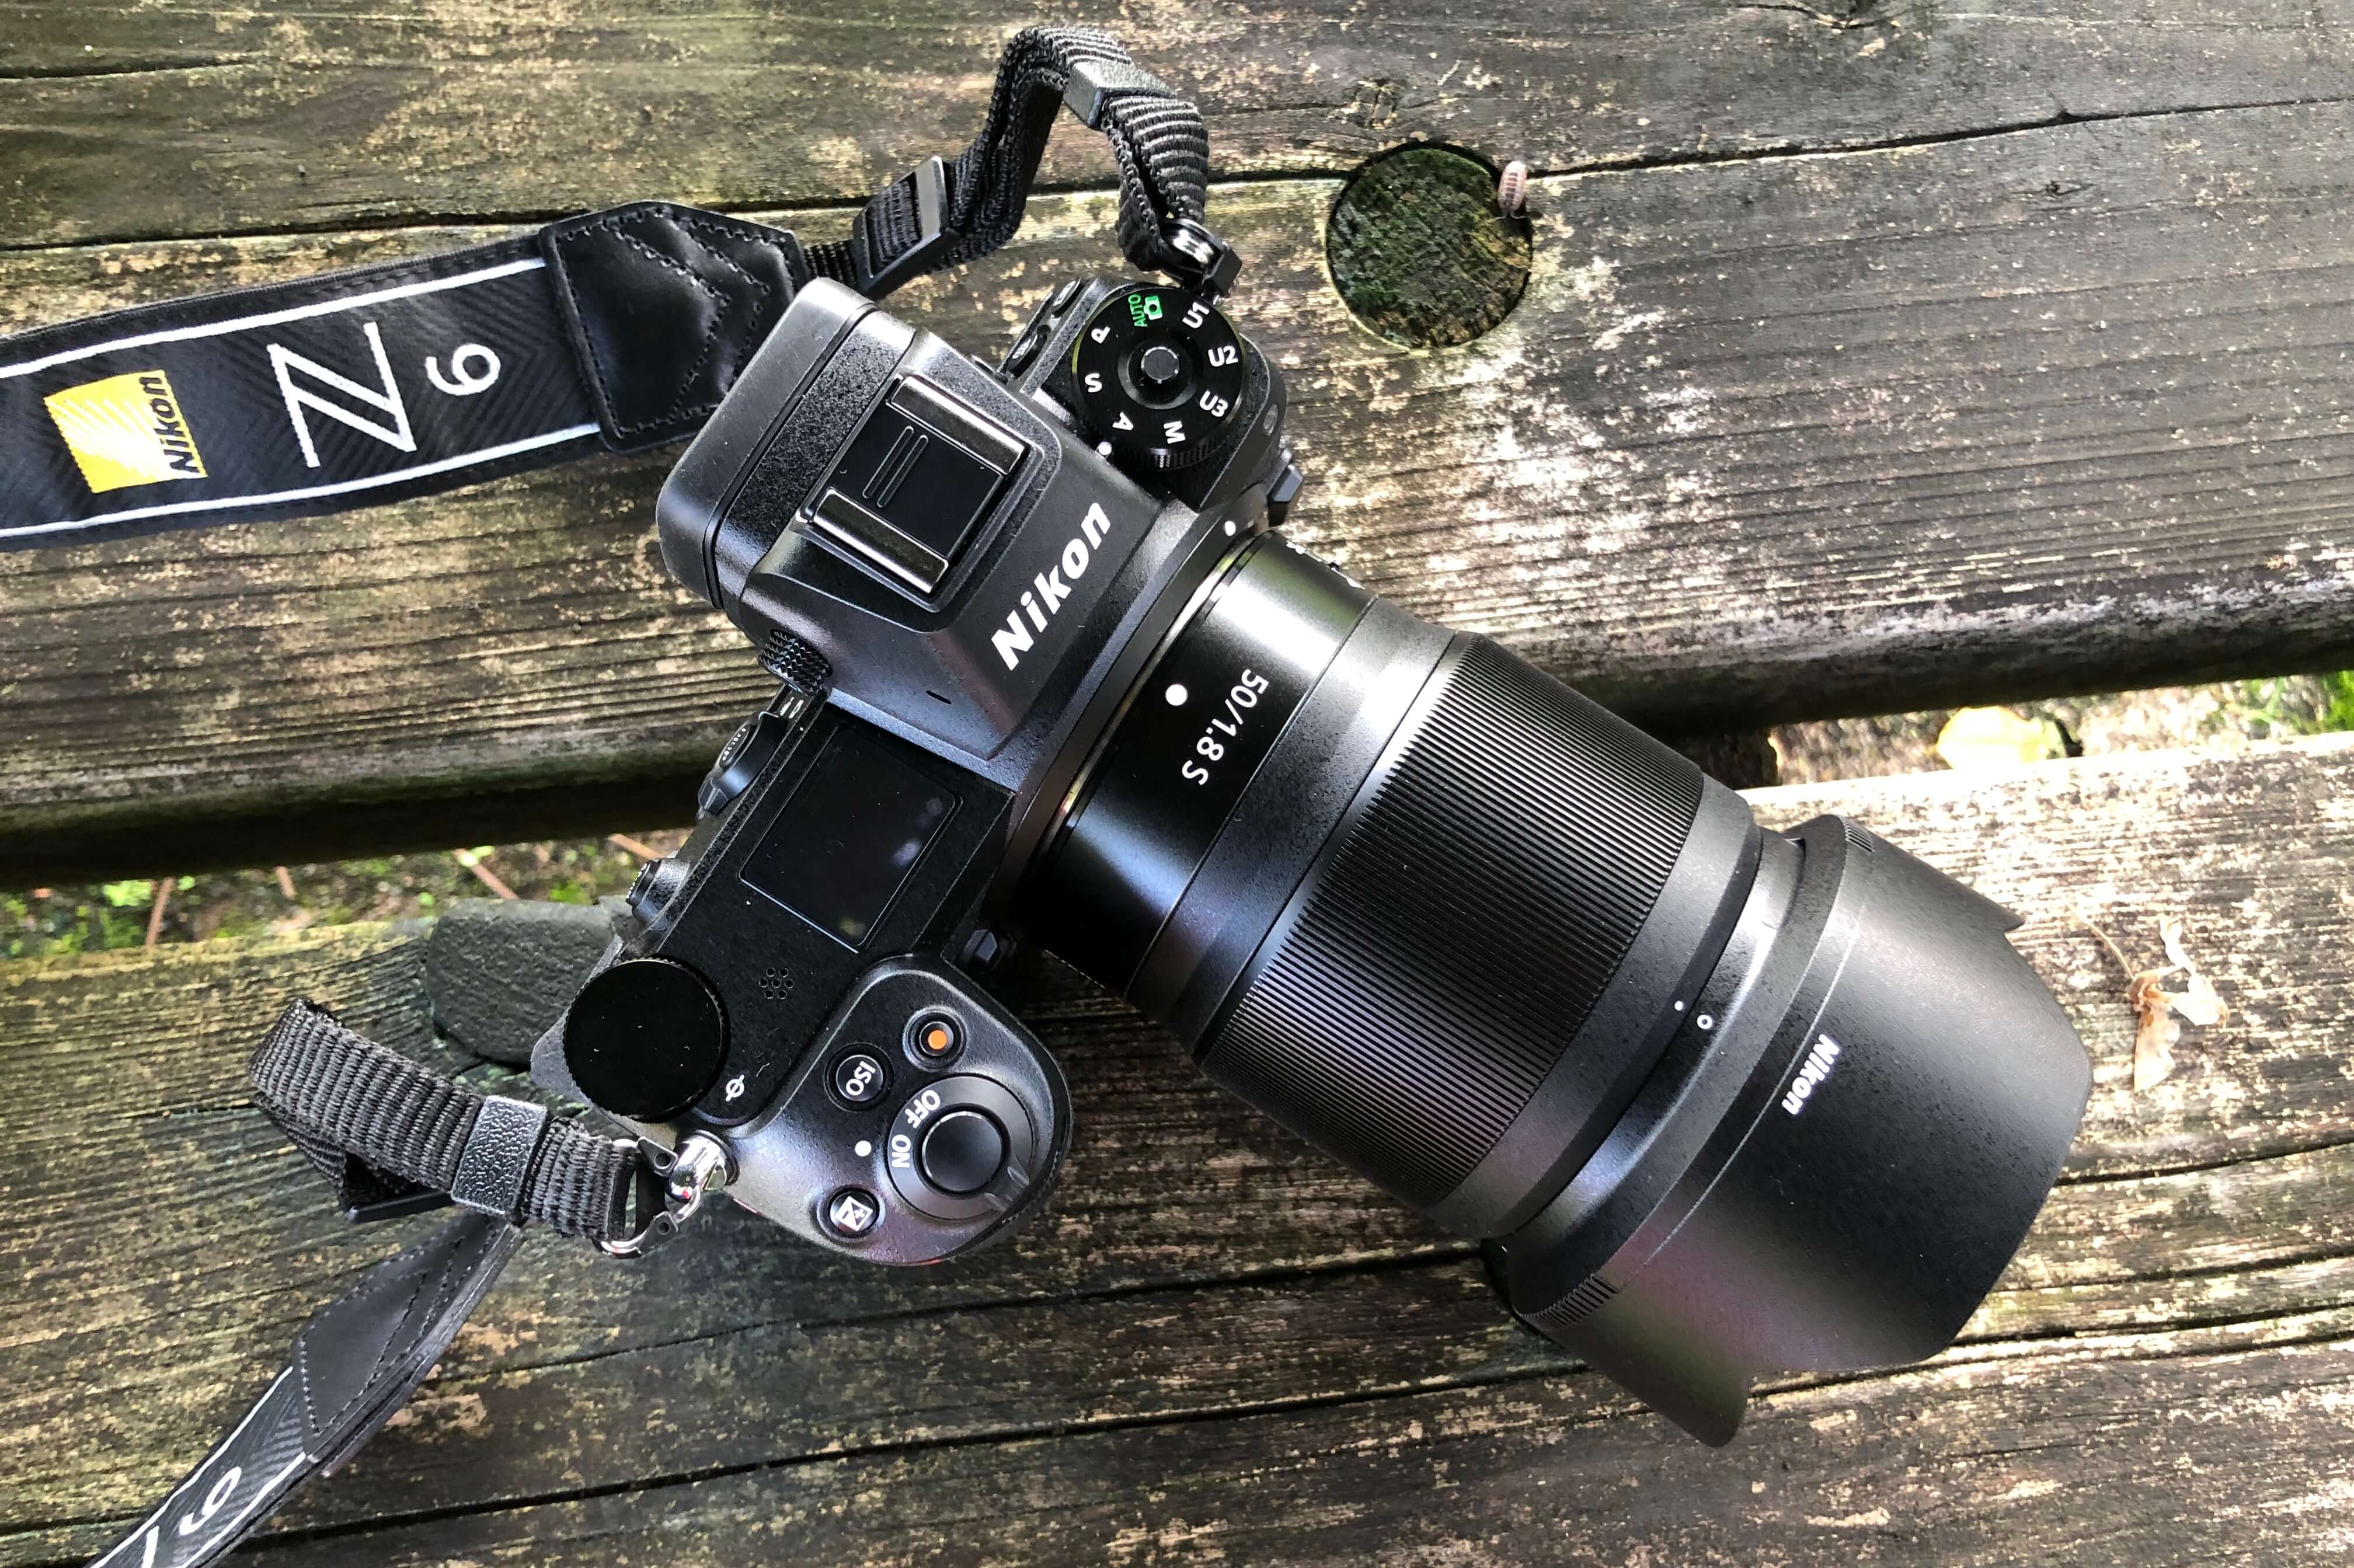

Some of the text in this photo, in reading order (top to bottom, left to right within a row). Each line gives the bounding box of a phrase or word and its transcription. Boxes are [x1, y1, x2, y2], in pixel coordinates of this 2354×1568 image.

[1128, 293, 1148, 328] AUTO
[1182, 301, 1211, 329] U1
[1091, 325, 1110, 344] P
[424, 343, 501, 396] 6
[1208, 345, 1238, 367] U2
[1085, 372, 1102, 393] S
[1199, 390, 1228, 418] U3
[138, 377, 200, 473] Nikon
[1112, 412, 1134, 433] A
[1163, 420, 1186, 444] M
[991, 502, 1111, 671] Nikon
[1182, 668, 1269, 785] 50/1.8 S
[845, 1061, 876, 1096] ISO
[1781, 1033, 1841, 1115] Nikon
[904, 1089, 941, 1128] OFF
[891, 1134, 912, 1168] ON
